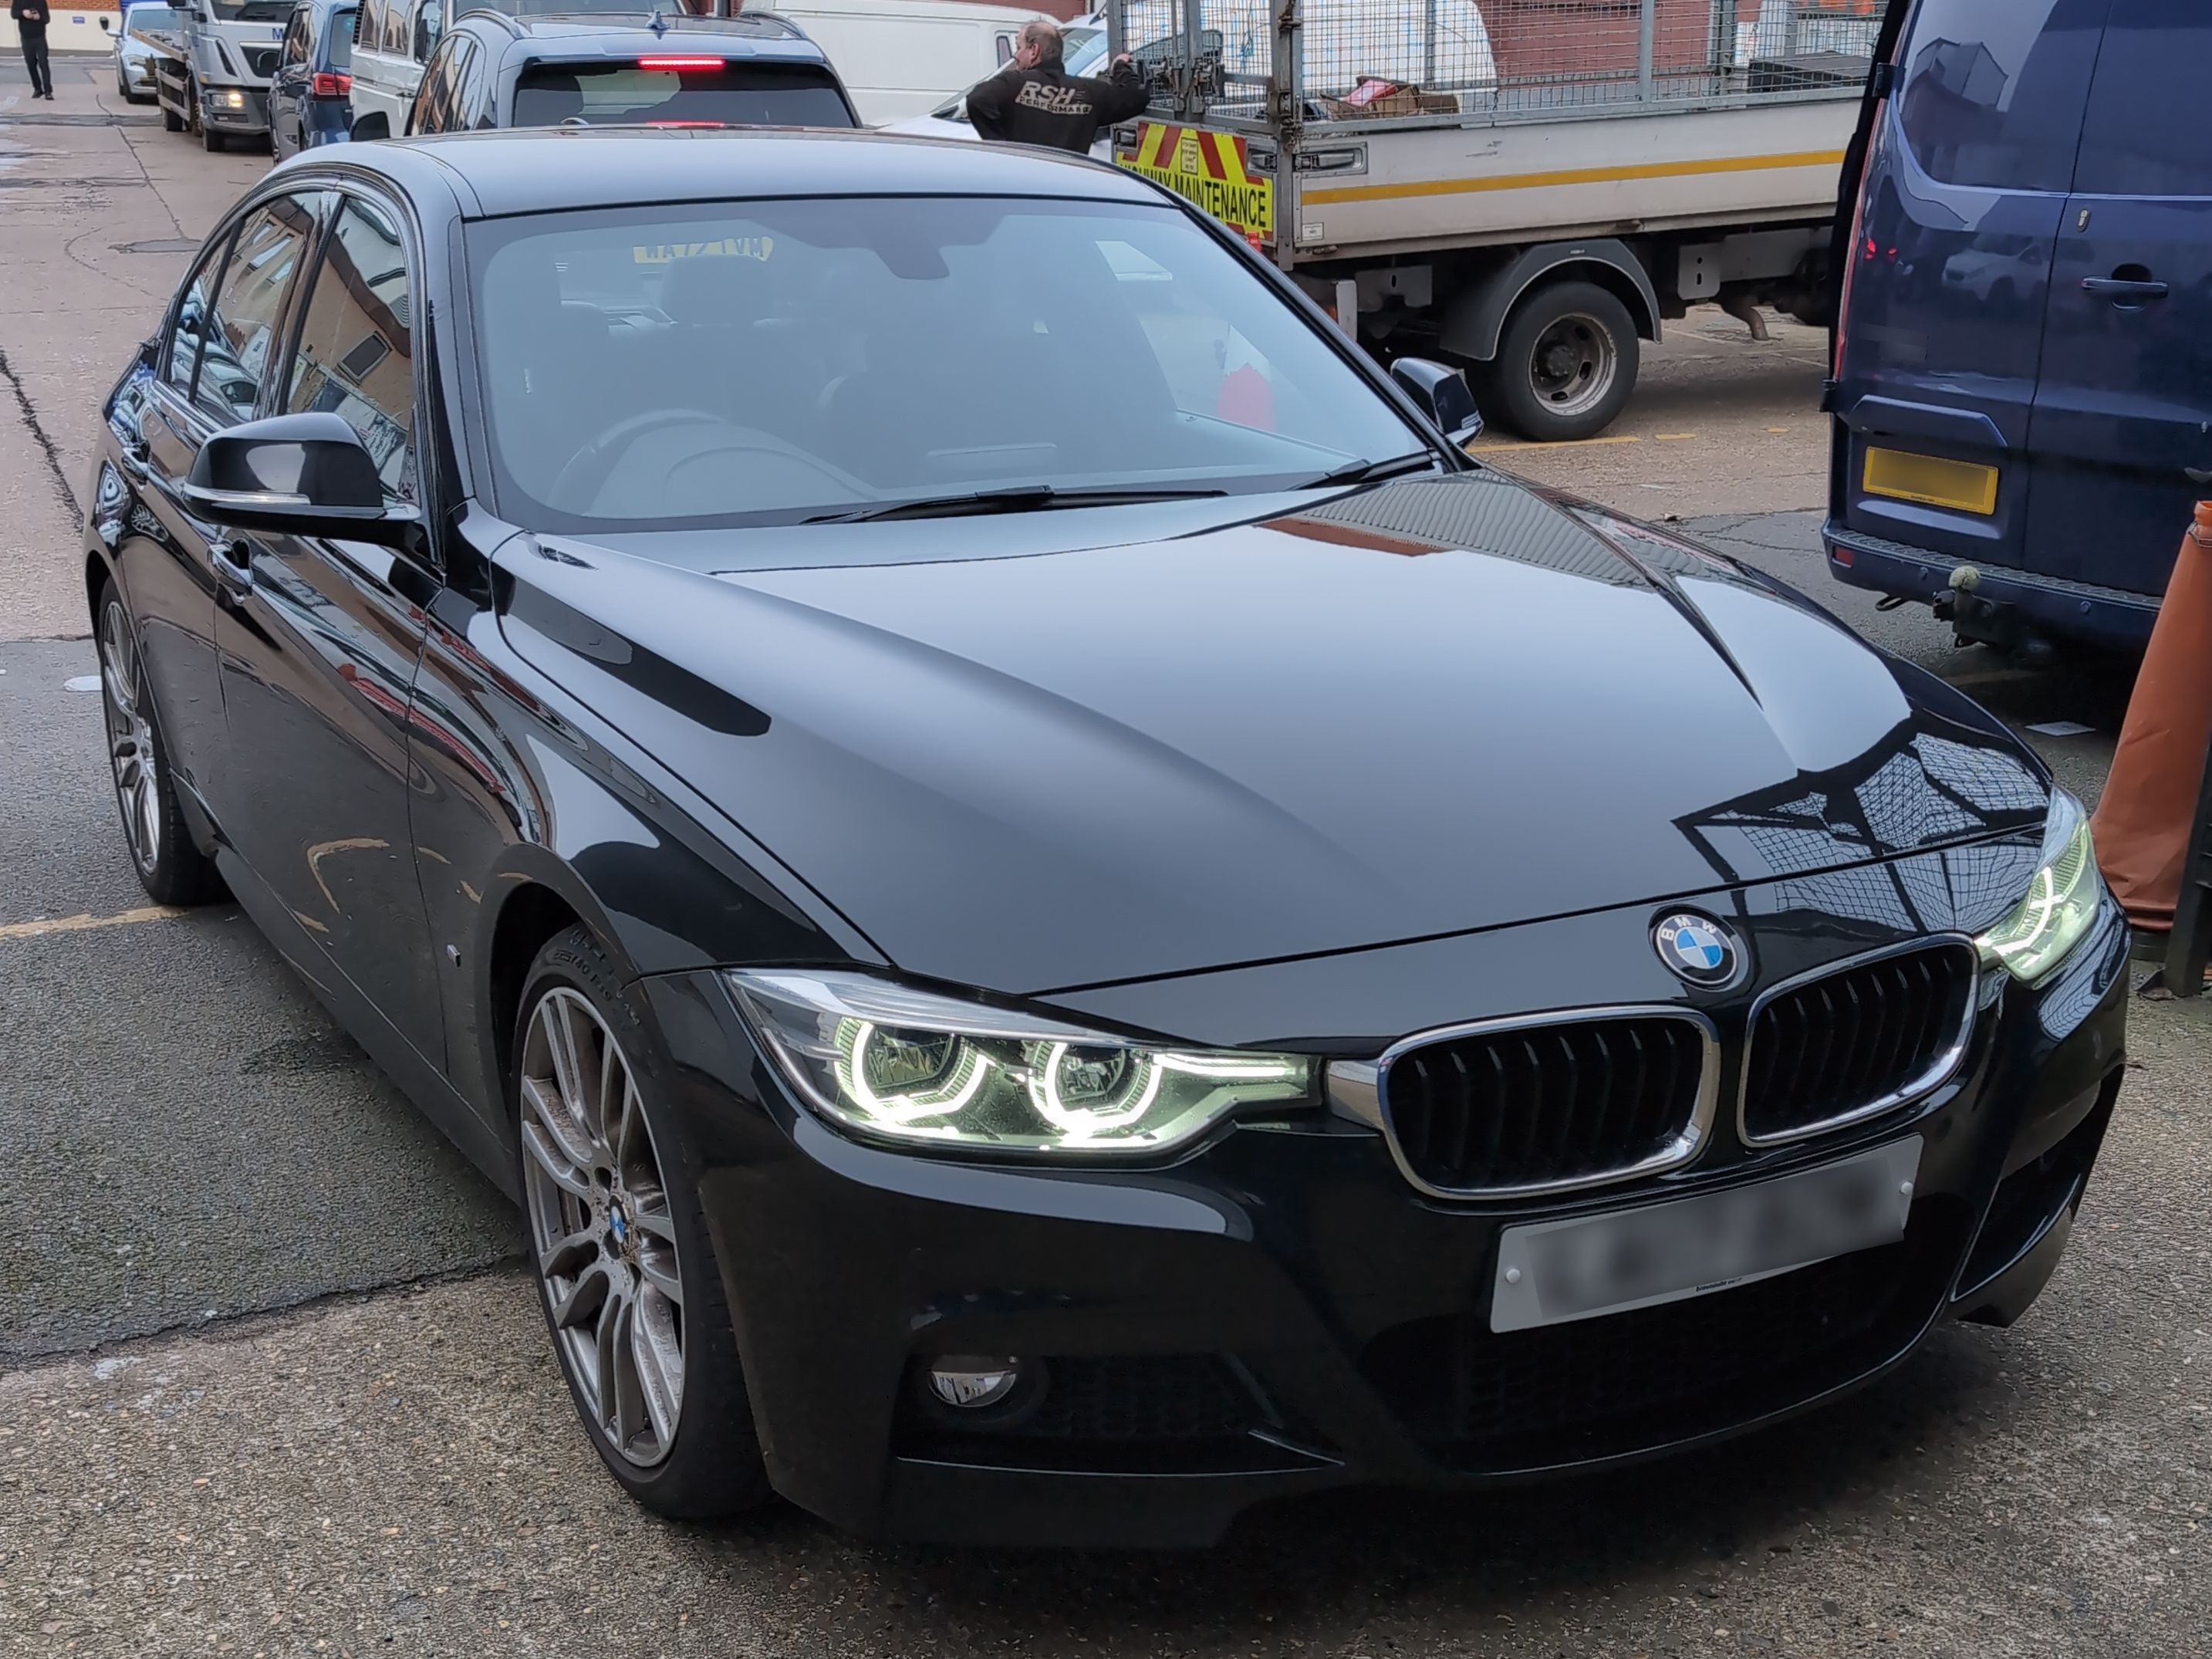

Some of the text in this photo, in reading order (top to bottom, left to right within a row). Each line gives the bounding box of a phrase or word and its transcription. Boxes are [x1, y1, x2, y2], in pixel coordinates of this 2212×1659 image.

[1019, 80, 1076, 106] RSH
[1174, 172, 1266, 228] MAINTENANCE
[1660, 916, 1717, 941] BMW
